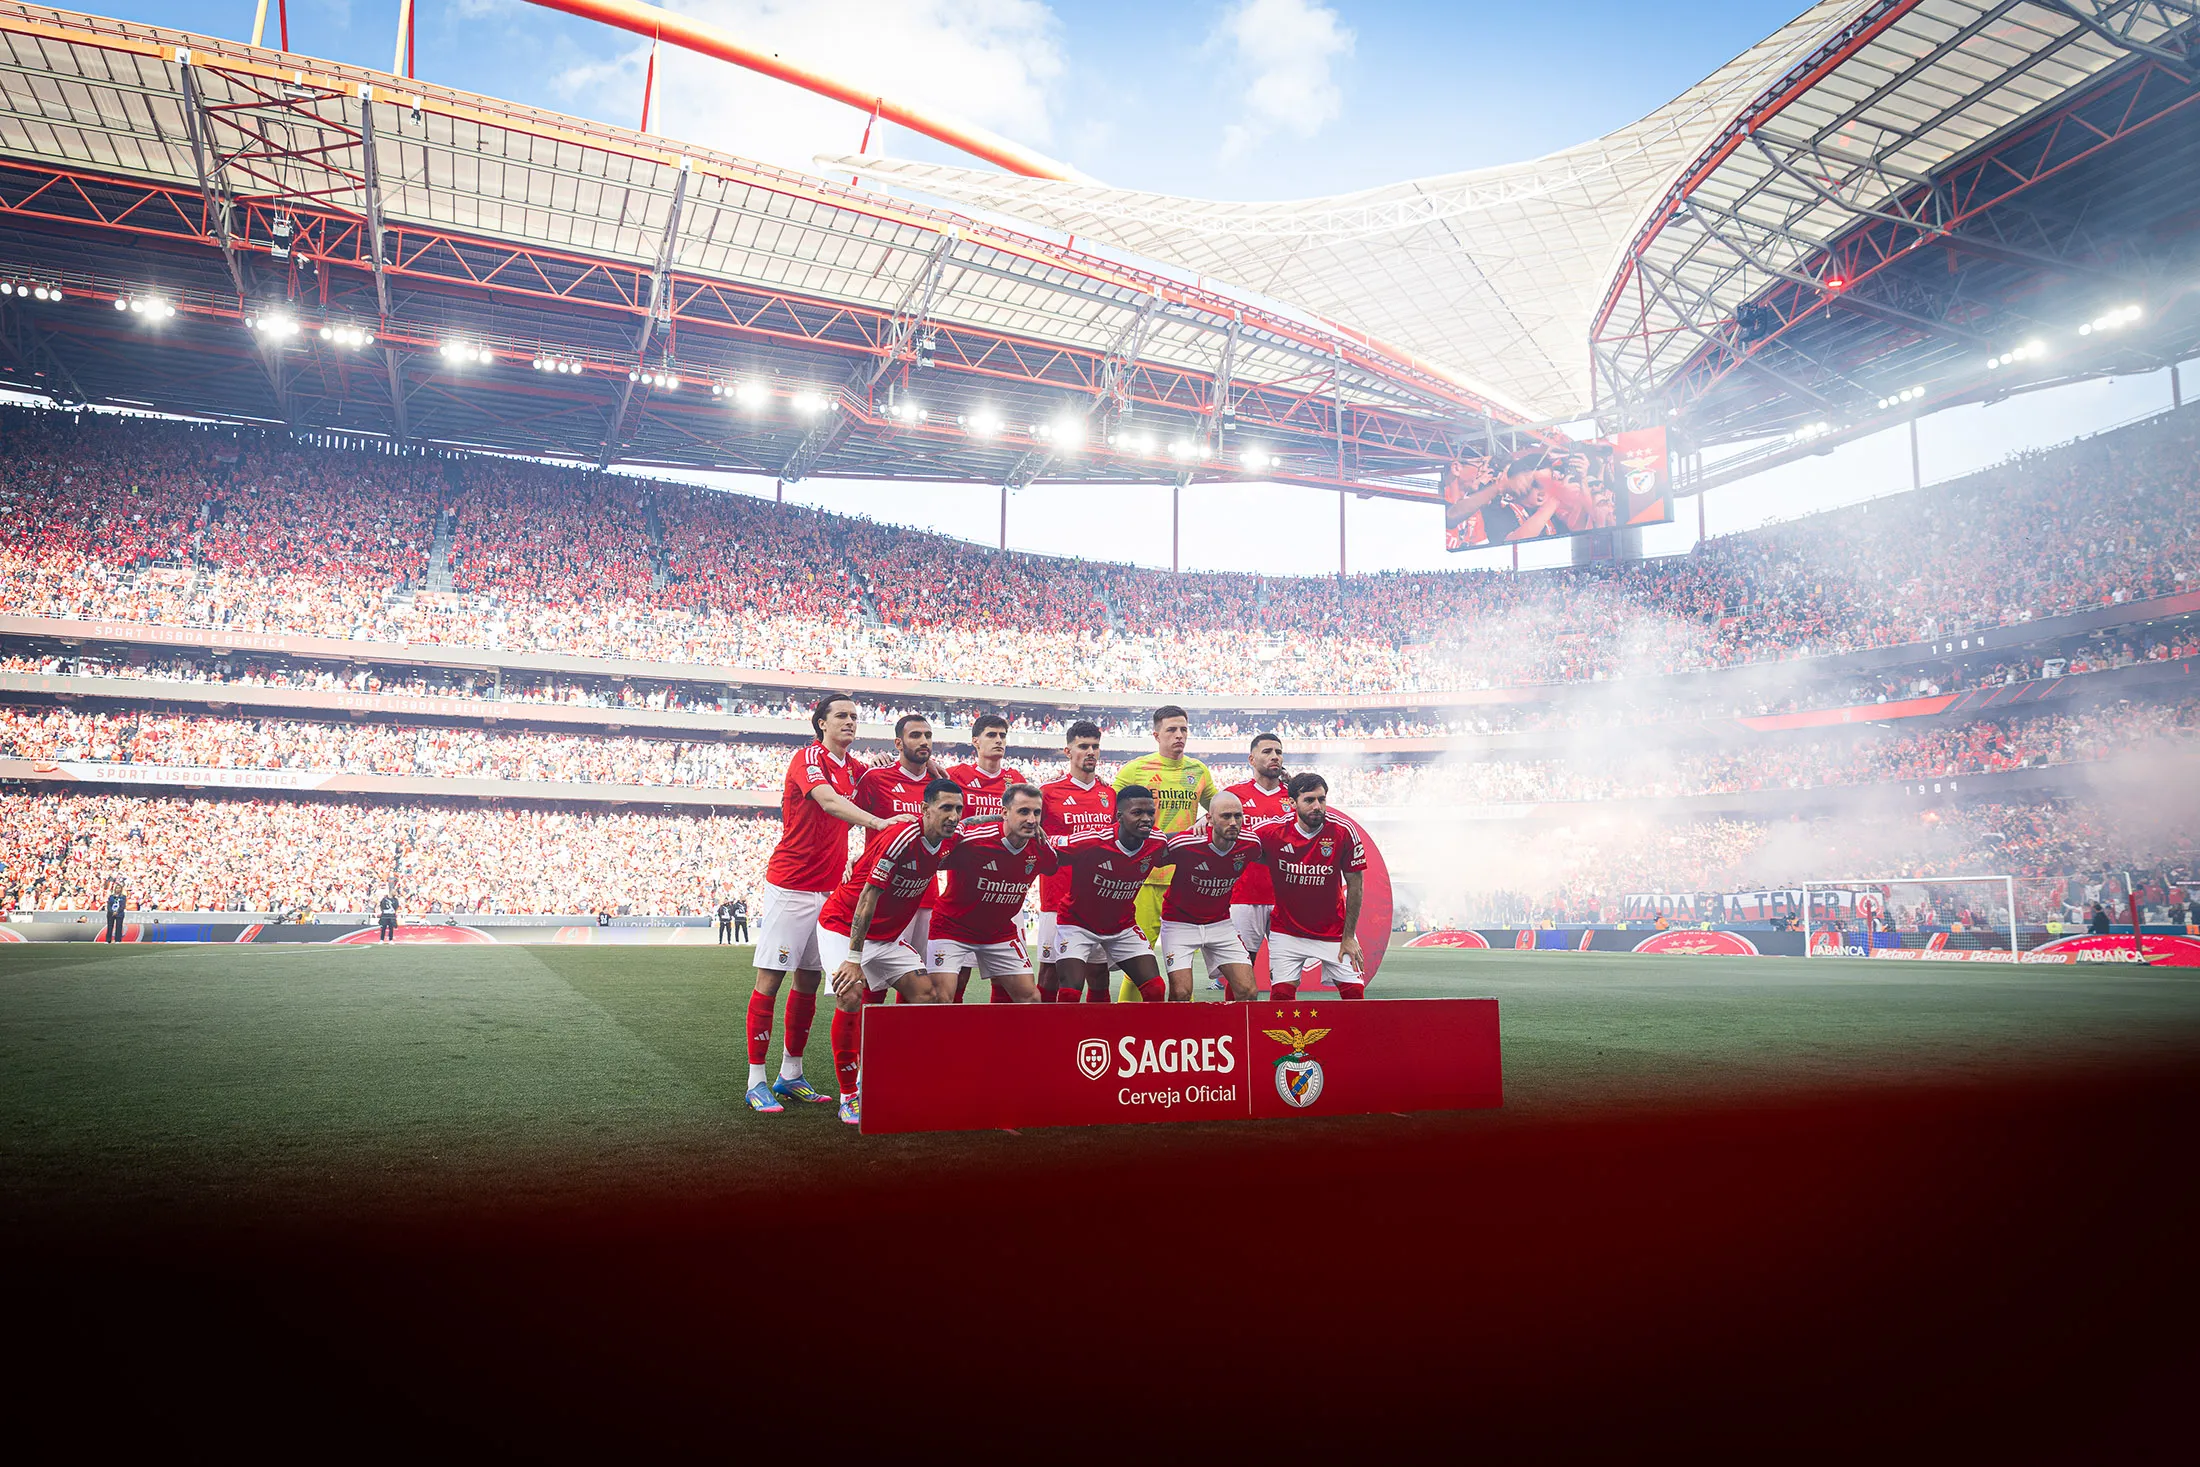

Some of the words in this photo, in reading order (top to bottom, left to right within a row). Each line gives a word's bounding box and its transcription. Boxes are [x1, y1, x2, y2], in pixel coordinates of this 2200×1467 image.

[94, 625, 144, 639] SPORT
[151, 629, 204, 643] LISBOA
[211, 633, 219, 644] E
[225, 635, 286, 649] BENFICA
[337, 696, 381, 708] SPORT
[388, 698, 436, 711] LISBOA
[442, 702, 449, 712] E
[455, 703, 510, 716] BENFICA
[96, 768, 148, 780] SPORT
[156, 770, 212, 783] LISBOA
[219, 773, 227, 783] E
[234, 774, 299, 786] BENFICA
[967, 793, 1003, 807] Emira
[1150, 788, 1198, 800] Emirates
[892, 799, 922, 813] Emir
[989, 807, 1001, 816] BET
[1158, 799, 1169, 809] FLY
[1171, 800, 1192, 810] BETTER
[1063, 811, 1112, 825] Emirates
[1278, 859, 1334, 875] Emirates
[976, 877, 1031, 893] Emirates
[1285, 873, 1298, 883] FLY
[1299, 875, 1325, 886] BETTER
[981, 892, 996, 903] FLY
[996, 893, 1021, 904] BETTER
[1097, 887, 1111, 898] FLY
[1197, 887, 1210, 895] FLY
[1814, 945, 1866, 957] ABANCA
[1876, 949, 1917, 960] Betano
[1921, 950, 1965, 961] Betano
[2020, 951, 2068, 964] Betano
[2080, 950, 2145, 963] ABANCA
[1117, 1035, 1235, 1078] SAGRES
[1118, 1087, 1181, 1108] Cerveja
[1185, 1085, 1236, 1103] Oficial
